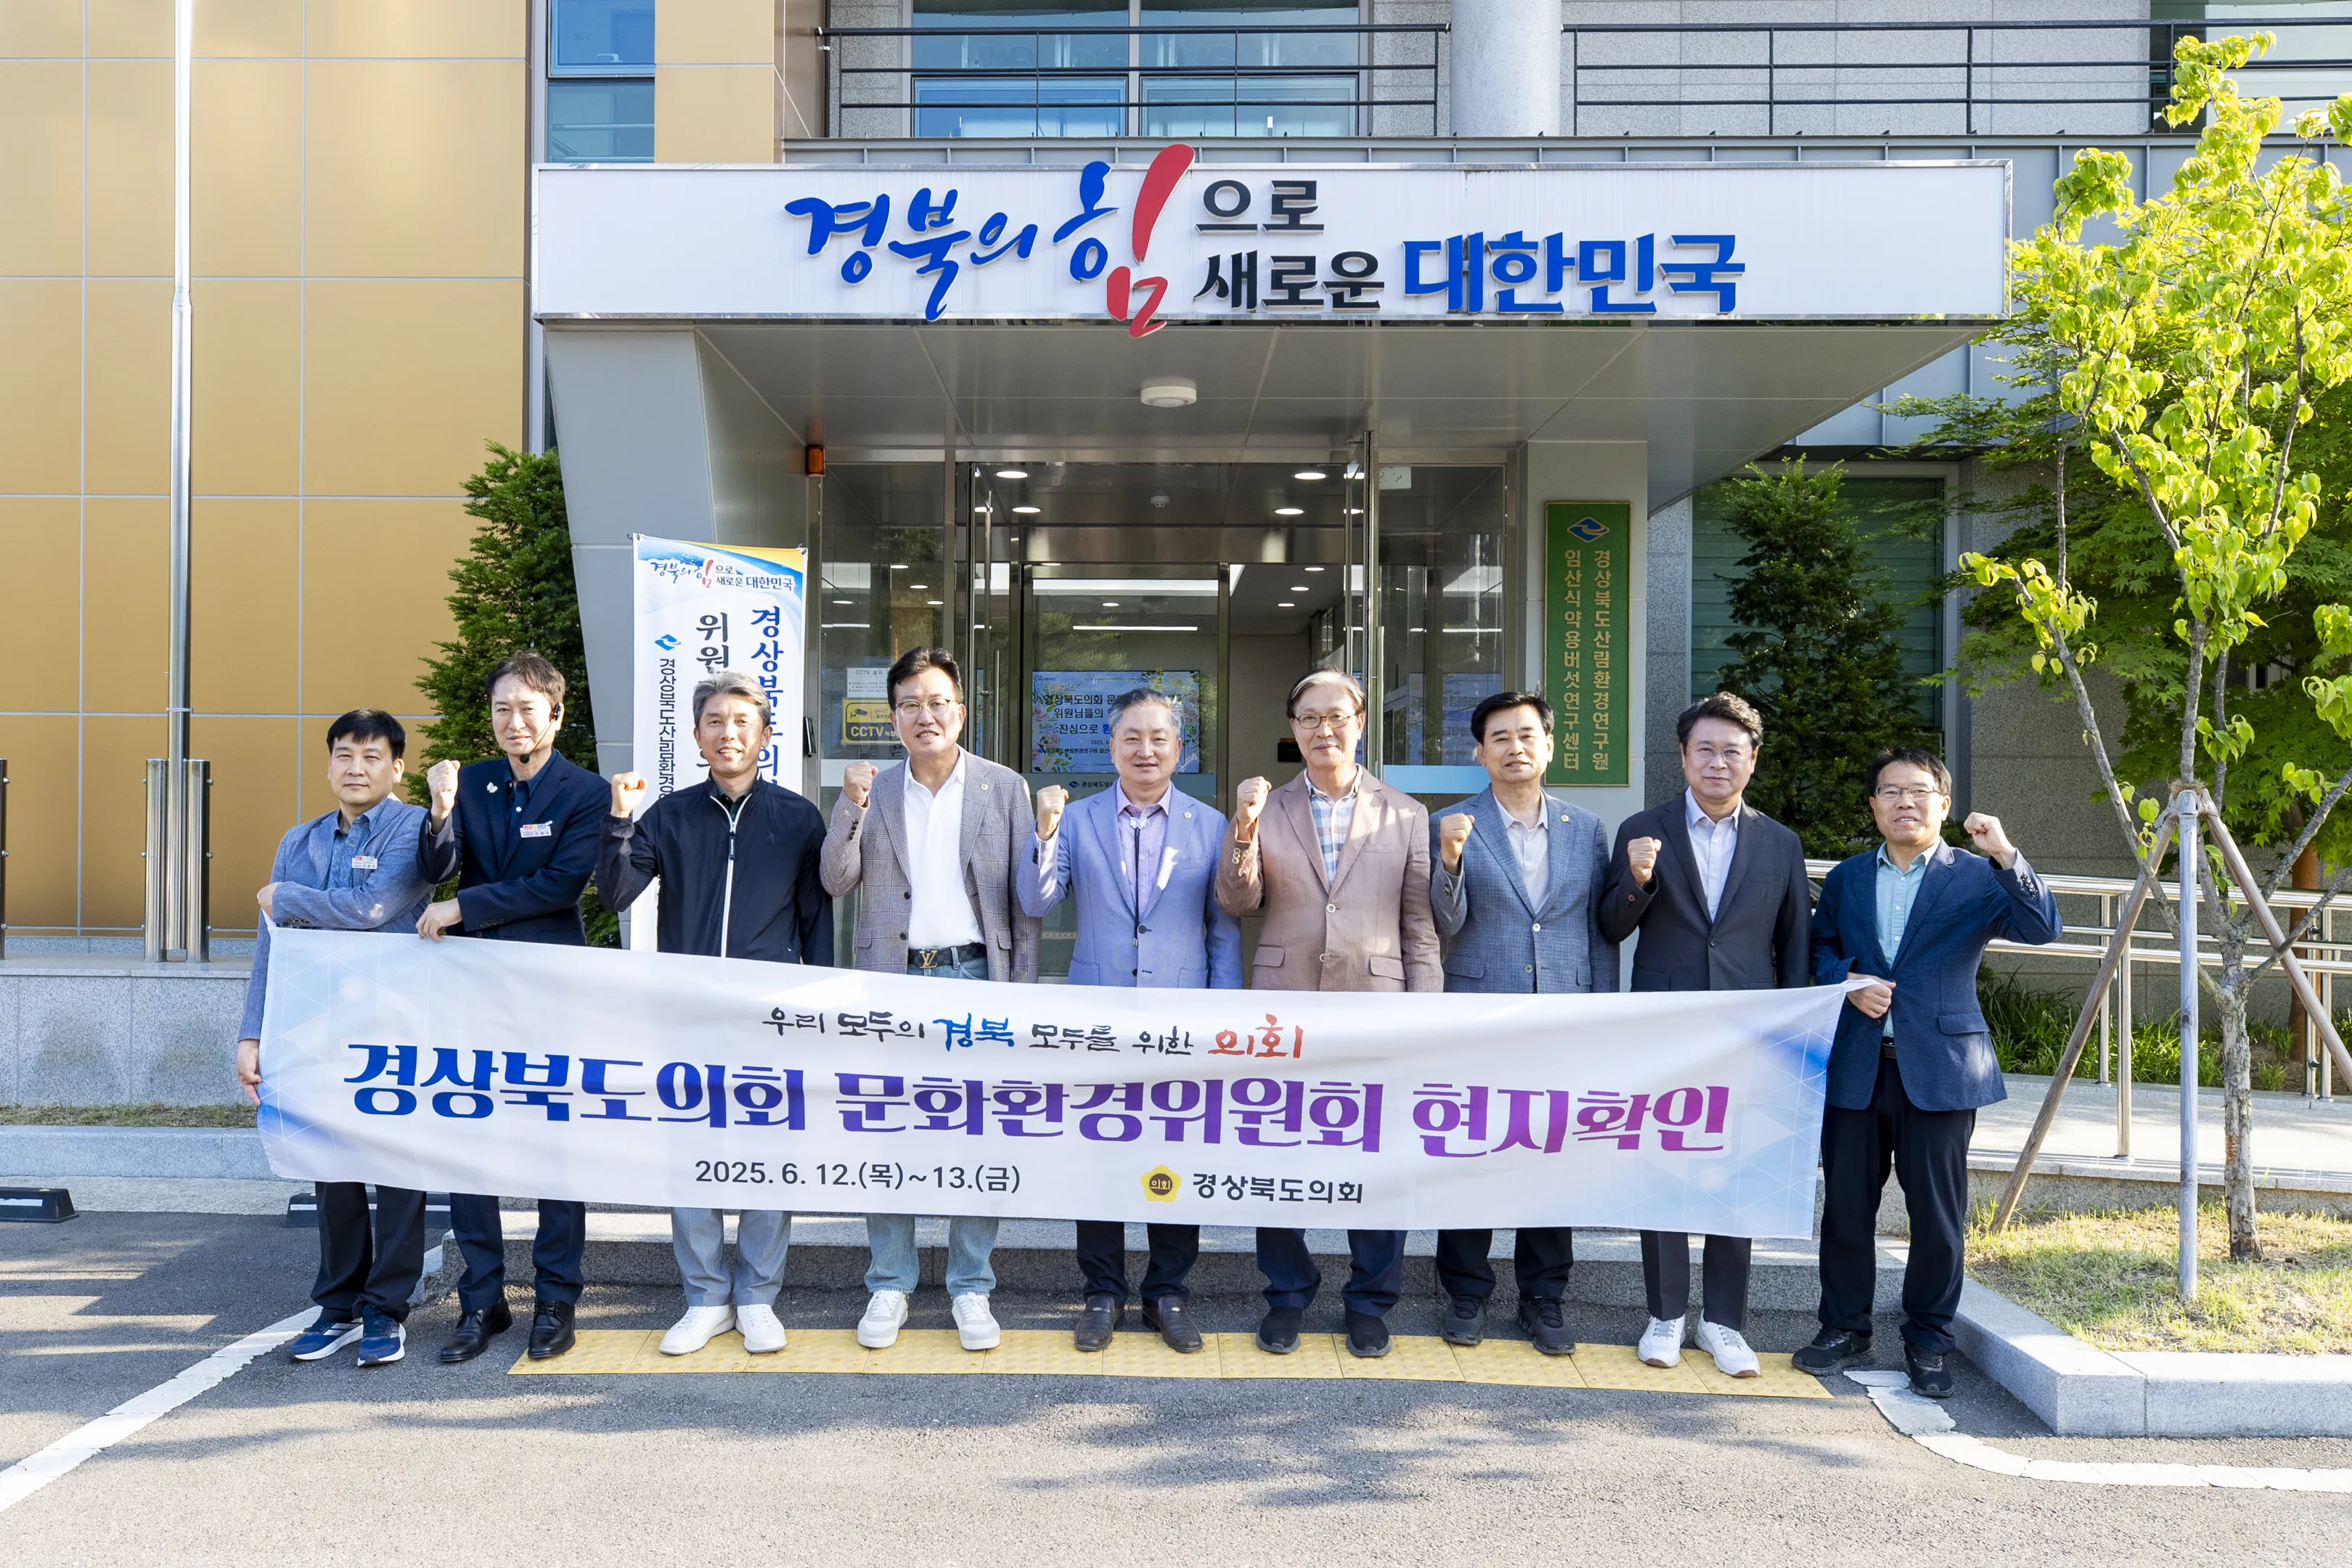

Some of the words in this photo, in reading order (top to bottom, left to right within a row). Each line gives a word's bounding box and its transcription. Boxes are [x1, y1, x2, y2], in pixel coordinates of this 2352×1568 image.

[1195, 179, 1325, 232] 으로
[1193, 250, 1385, 311] 새로운
[1403, 230, 1747, 314] 대한민국
[715, 565, 735, 574] 으로
[716, 577, 743, 587] 새로운
[746, 577, 793, 591] 대한민국
[1562, 550, 1583, 771] 임산식약용버섯연구센터
[1592, 550, 1612, 771] 경상북도산림환경연구원
[1045, 695, 1103, 706] 경상북도의회
[1054, 708, 1103, 719] 위원님들의
[850, 726, 884, 738] CCTV
[1059, 724, 1098, 735] 진심으로
[762, 1007, 825, 1037] 우리
[837, 1010, 926, 1043] 모두의
[932, 1013, 1015, 1052] 경북
[1028, 1024, 1122, 1053] 모두를
[1131, 1026, 1195, 1056] 위한
[1208, 1013, 1304, 1059] 의회
[343, 1043, 807, 1132] 경상북도의회
[833, 1071, 1384, 1153] 문화환경위원회
[1412, 1082, 1730, 1159] 현지확인
[695, 1160, 774, 1184] 2025.
[781, 1162, 807, 1185] 6.
[1150, 1180, 1171, 1191] 의회
[1193, 1173, 1363, 1204] 경상북도의회
